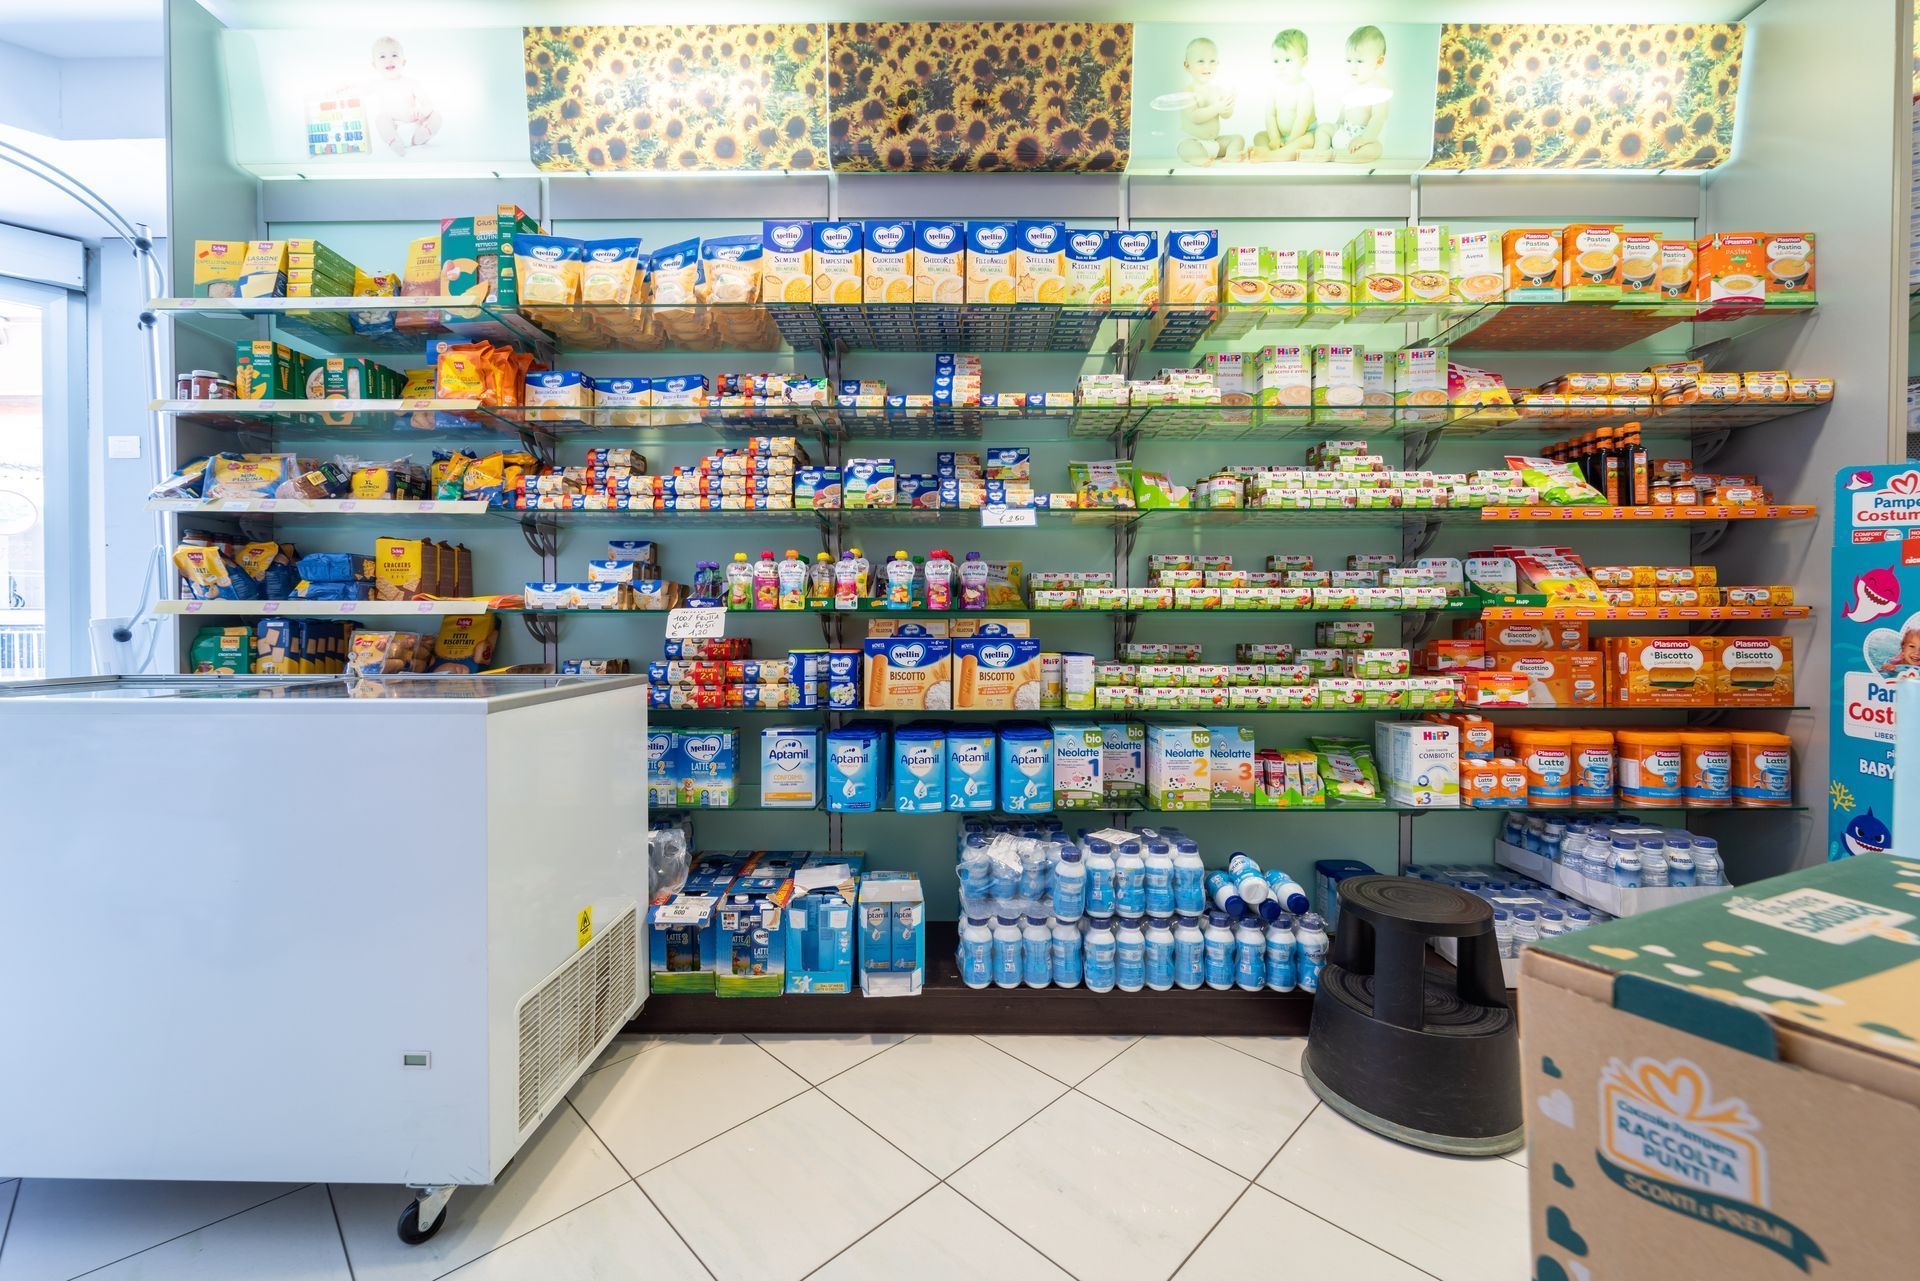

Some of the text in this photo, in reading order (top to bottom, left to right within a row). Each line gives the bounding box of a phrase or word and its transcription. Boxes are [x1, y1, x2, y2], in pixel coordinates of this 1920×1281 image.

[776, 231, 798, 240] Mellin
[825, 232, 848, 241] Mellin
[877, 232, 900, 240] Mellin
[929, 232, 951, 241] Mellin
[981, 232, 1003, 240] Mellin
[1030, 232, 1052, 240] Mellin
[1586, 228, 1610, 236] Plasmon
[1075, 239, 1098, 248] Mellin
[1123, 240, 1146, 248] Mellin
[1183, 239, 1205, 248] Mellin
[1462, 234, 1487, 245] HiPP
[1525, 240, 1550, 248] Pastina
[1277, 347, 1300, 356] HiPP
[1331, 347, 1353, 355] HiPP
[1411, 350, 1435, 359] HiPP
[1219, 354, 1241, 363] HiPP
[895, 650, 920, 659] Mellin
[985, 651, 1009, 659] Mellin
[1654, 651, 1694, 660] Biscotto
[1735, 651, 1774, 660] Biscotto
[831, 661, 850, 669] Mellin
[889, 671, 926, 681] BISCOTTO
[979, 671, 1015, 681] BISCOTTO
[1848, 702, 1894, 725] Cost
[1128, 728, 1144, 737] bio
[1423, 731, 1450, 741] HiPP
[1085, 733, 1102, 744] bio
[1193, 733, 1210, 744] bio
[690, 744, 716, 753] Mellin
[1102, 741, 1142, 750] Neolatte
[769, 749, 809, 760] Aptamil
[1057, 748, 1099, 757] Neolatte
[1165, 749, 1204, 758] Neolatte
[1210, 749, 1251, 759] Neolatte
[830, 753, 869, 764] Aptamil
[900, 754, 939, 766] Aptamil
[951, 752, 990, 763] Aptamil
[1010, 754, 1049, 765] Aptamil
[1131, 751, 1141, 769] 1
[1538, 758, 1565, 767] Latte
[691, 762, 718, 776] LATTE 2
[1088, 758, 1099, 777] 1
[1194, 758, 1209, 777] 2
[1239, 762, 1252, 780] 3
[1859, 758, 1896, 780] BABY
[950, 794, 958, 808] 2
[1009, 796, 1018, 810] 3
[1423, 792, 1432, 805] 3
[899, 797, 907, 810] 2
[867, 912, 888, 920] ptamil
[792, 976, 803, 993] 3
[1618, 1116, 1739, 1183] RACCOLTA
[1643, 1144, 1711, 1186] PUNTI
[1624, 1174, 1698, 1212] SCONTI
[1712, 1203, 1793, 1249] PREMI
